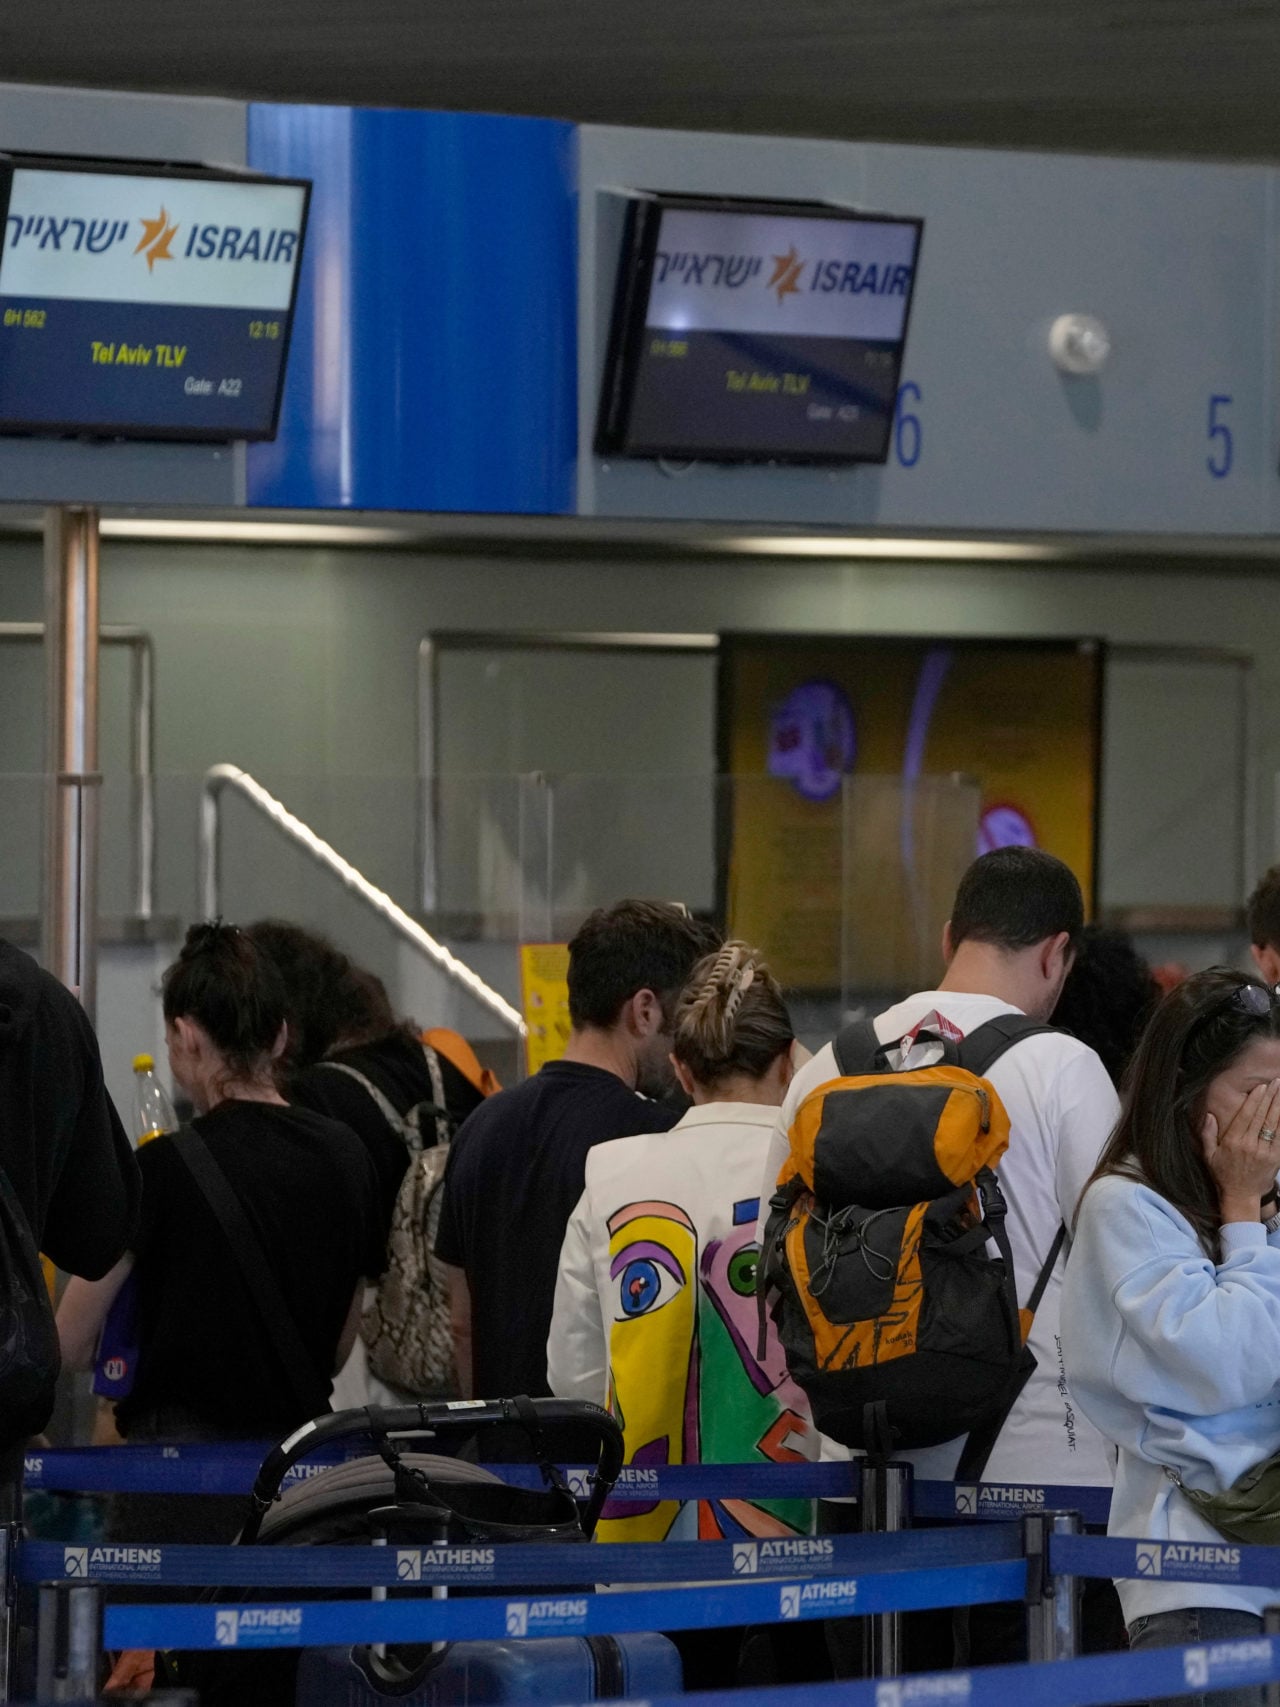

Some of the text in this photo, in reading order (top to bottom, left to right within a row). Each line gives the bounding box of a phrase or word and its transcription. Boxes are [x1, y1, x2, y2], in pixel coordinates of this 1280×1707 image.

[184, 223, 299, 263] ISRAIR
[810, 259, 911, 297] ISRAIR
[91, 341, 187, 368] Tel Aviv TLV
[896, 381, 921, 467] 6
[1208, 394, 1233, 479] 5
[979, 1487, 1046, 1502] ATHENS
[90, 1547, 162, 1563] ATHENS
[422, 1549, 495, 1564] ATHENS
[760, 1539, 834, 1557] ATHENS
[1163, 1545, 1241, 1564] ATHENS
[801, 1580, 857, 1600] ATHENS
[239, 1608, 302, 1626] ATHENS
[529, 1600, 588, 1618] ATHENS
